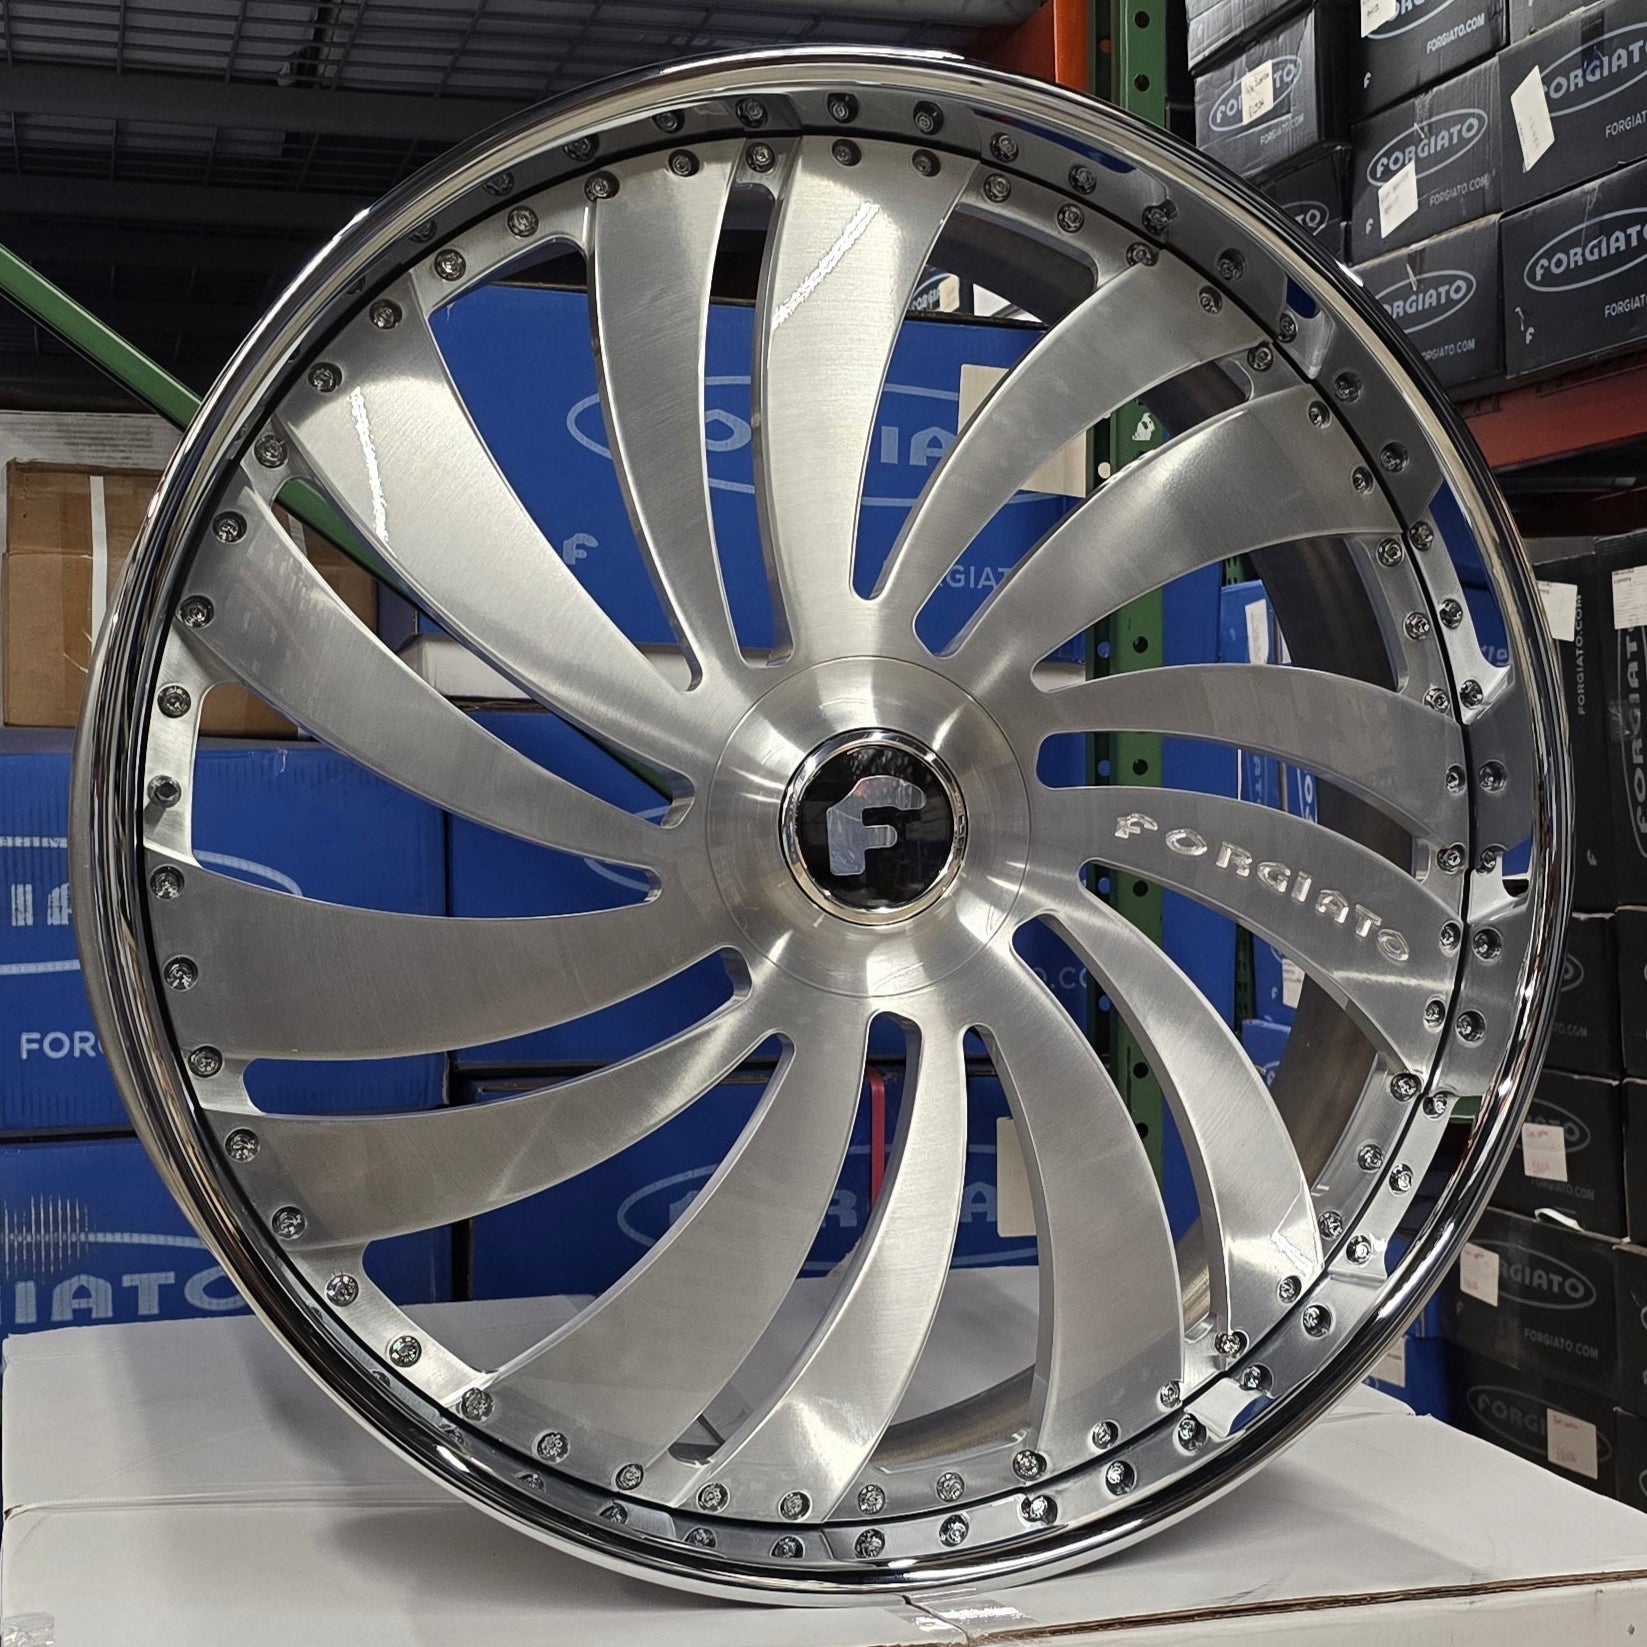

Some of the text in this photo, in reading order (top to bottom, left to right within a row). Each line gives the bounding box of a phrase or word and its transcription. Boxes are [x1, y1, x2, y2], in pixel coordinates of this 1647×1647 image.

[1427, 13, 1485, 54] FORGIATO.COM
[1376, 117, 1479, 178] FORGIATO
[826, 775, 926, 876] F
[1114, 812, 1410, 962] FORGIATO
[1524, 1327, 1598, 1360] FORGIATO.COM
